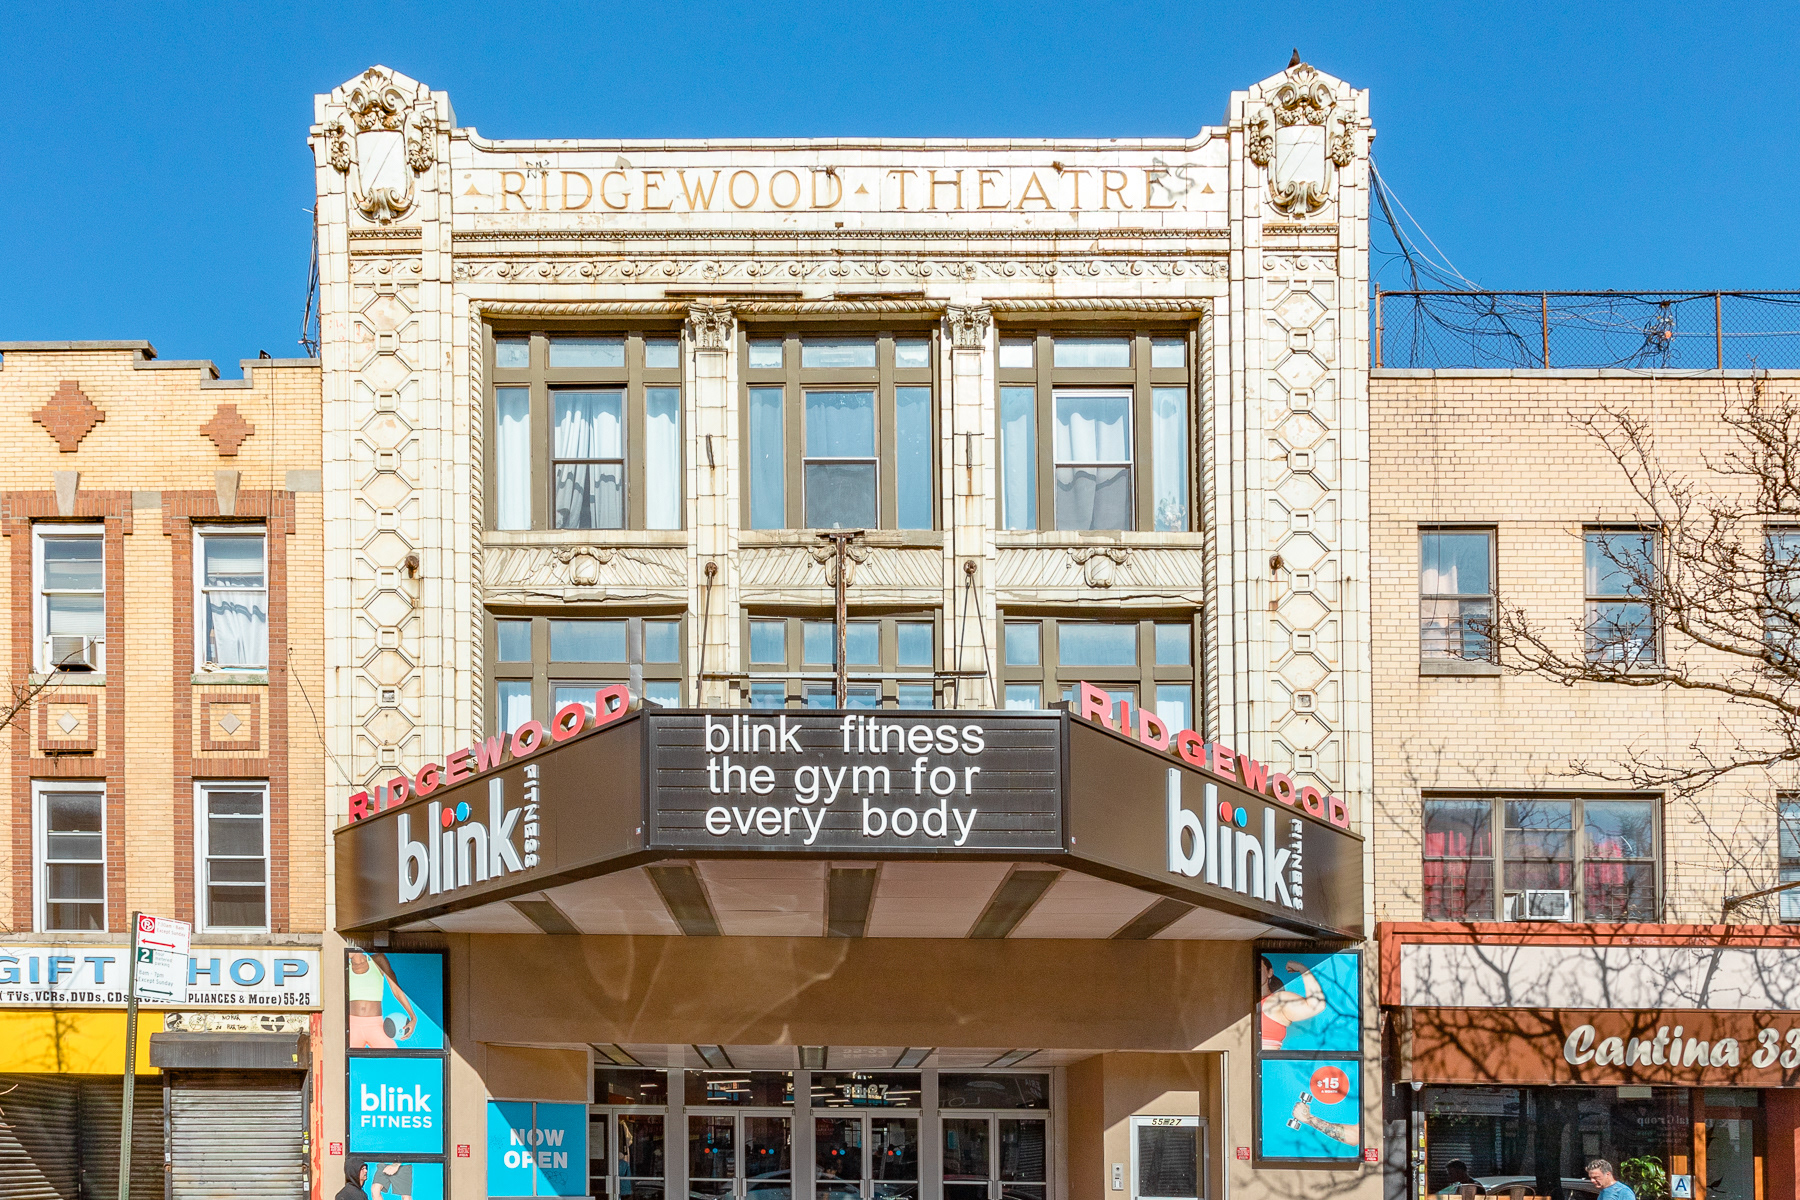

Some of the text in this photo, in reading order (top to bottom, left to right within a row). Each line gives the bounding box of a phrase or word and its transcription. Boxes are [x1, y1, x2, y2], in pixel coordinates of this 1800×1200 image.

[499, 169, 842, 211] RIDGEWOOD
[886, 169, 1177, 211] THEATRE
[349, 684, 634, 823] RIDGEWOOD
[704, 714, 985, 755] blink fitness
[1077, 680, 1350, 829] RIDGEWOOD
[706, 757, 981, 805] the gym for
[523, 763, 541, 869] FITNESS
[704, 799, 978, 847] every body
[397, 777, 526, 904] blink
[1166, 767, 1293, 909] blink
[1288, 818, 1304, 911] FITNESS
[0, 955, 310, 987] GIFT HOP
[140, 948, 151, 962] 2
[138, 976, 174, 987] Except Sunday
[239, 995, 245, 1004] &
[249, 993, 282, 1006] More)
[283, 993, 311, 1006] 55-25
[1563, 1024, 1800, 1069] Cantina 33
[360, 1083, 432, 1112] blink
[1317, 1077, 1339, 1089] $15
[360, 1115, 433, 1128] FITNESS
[509, 1127, 565, 1147] NOW
[503, 1150, 568, 1169] OPEN
[1675, 1177, 1687, 1192] A
